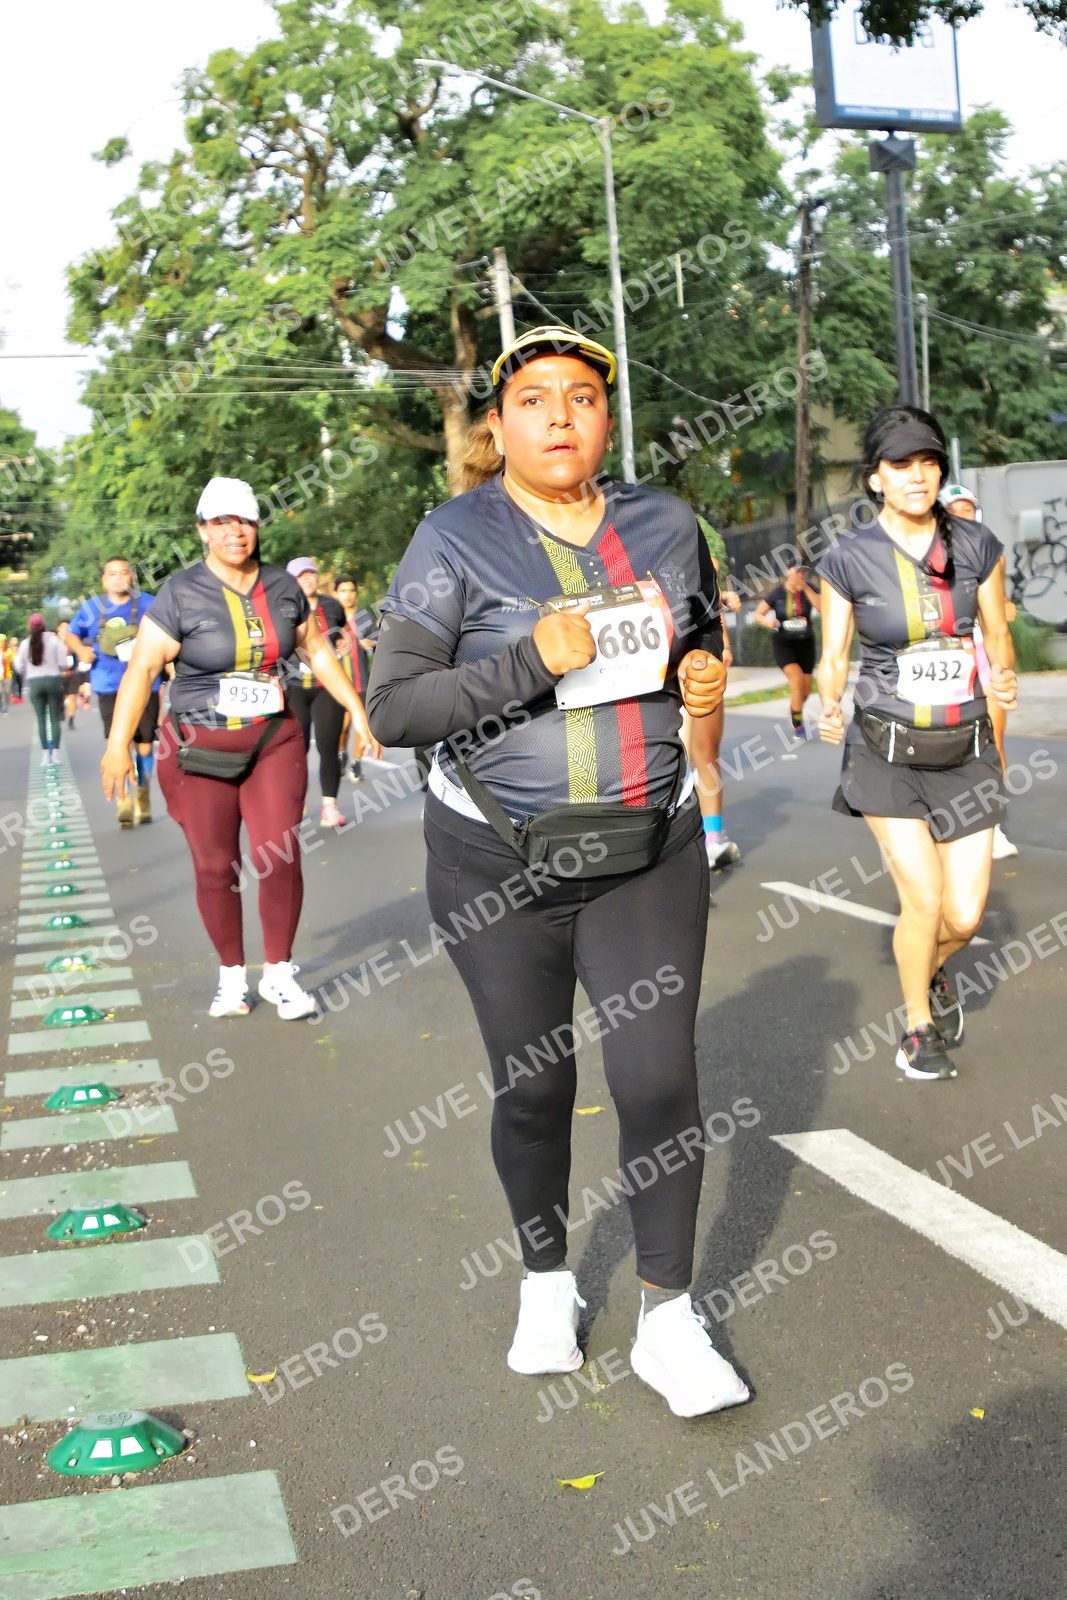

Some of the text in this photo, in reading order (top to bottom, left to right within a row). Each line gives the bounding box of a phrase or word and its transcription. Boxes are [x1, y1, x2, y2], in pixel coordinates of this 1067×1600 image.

[597, 615, 660, 659] 686
[911, 660, 962, 681] 9432
[229, 685, 269, 704] 9557
